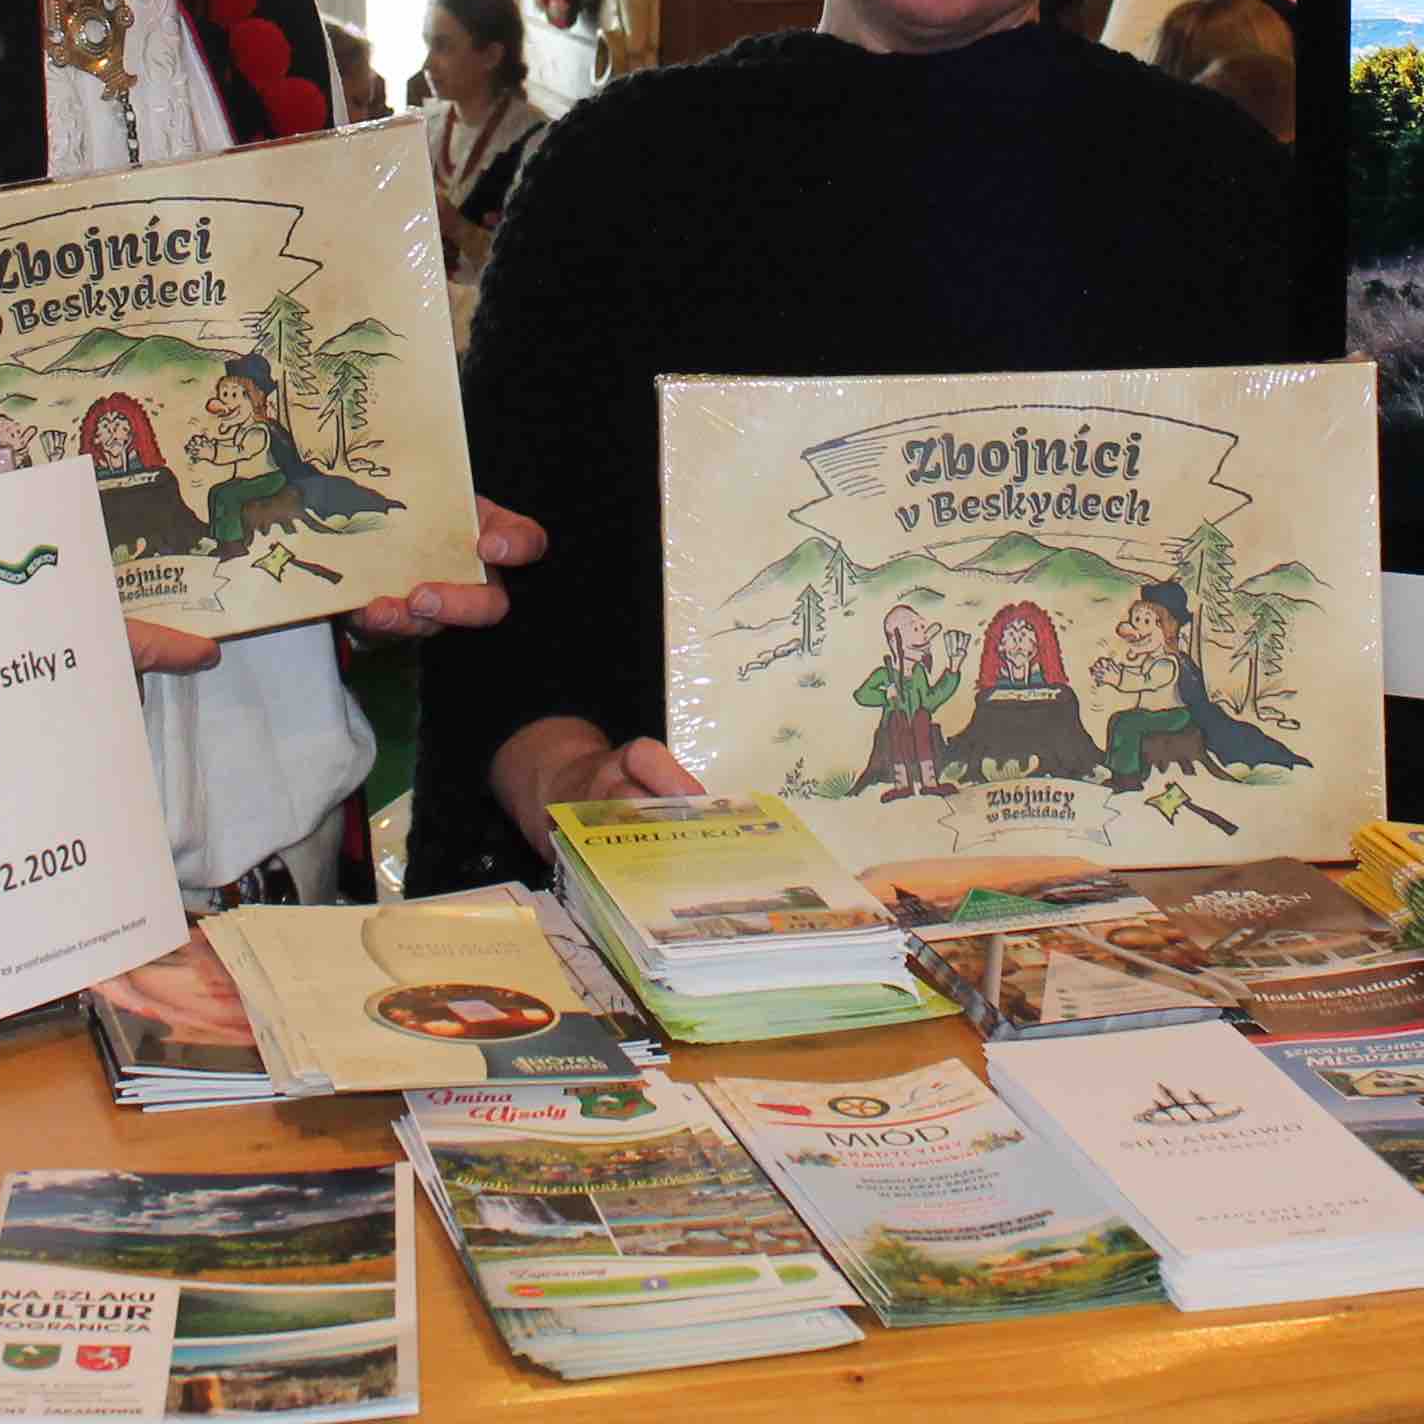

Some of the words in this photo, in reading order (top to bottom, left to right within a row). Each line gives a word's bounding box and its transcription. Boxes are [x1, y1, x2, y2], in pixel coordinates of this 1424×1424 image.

[9, 270, 227, 335] Beskydech
[903, 425, 1143, 483] Zbojníci
[896, 500, 922, 533] v
[930, 483, 1152, 531] Beskydech
[116, 563, 185, 590] bójnicy
[62, 647, 78, 671] a
[826, 1125, 950, 1148] MIÓD
[0, 1289, 42, 1301] NA
[52, 1289, 156, 1303] SZLAKU
